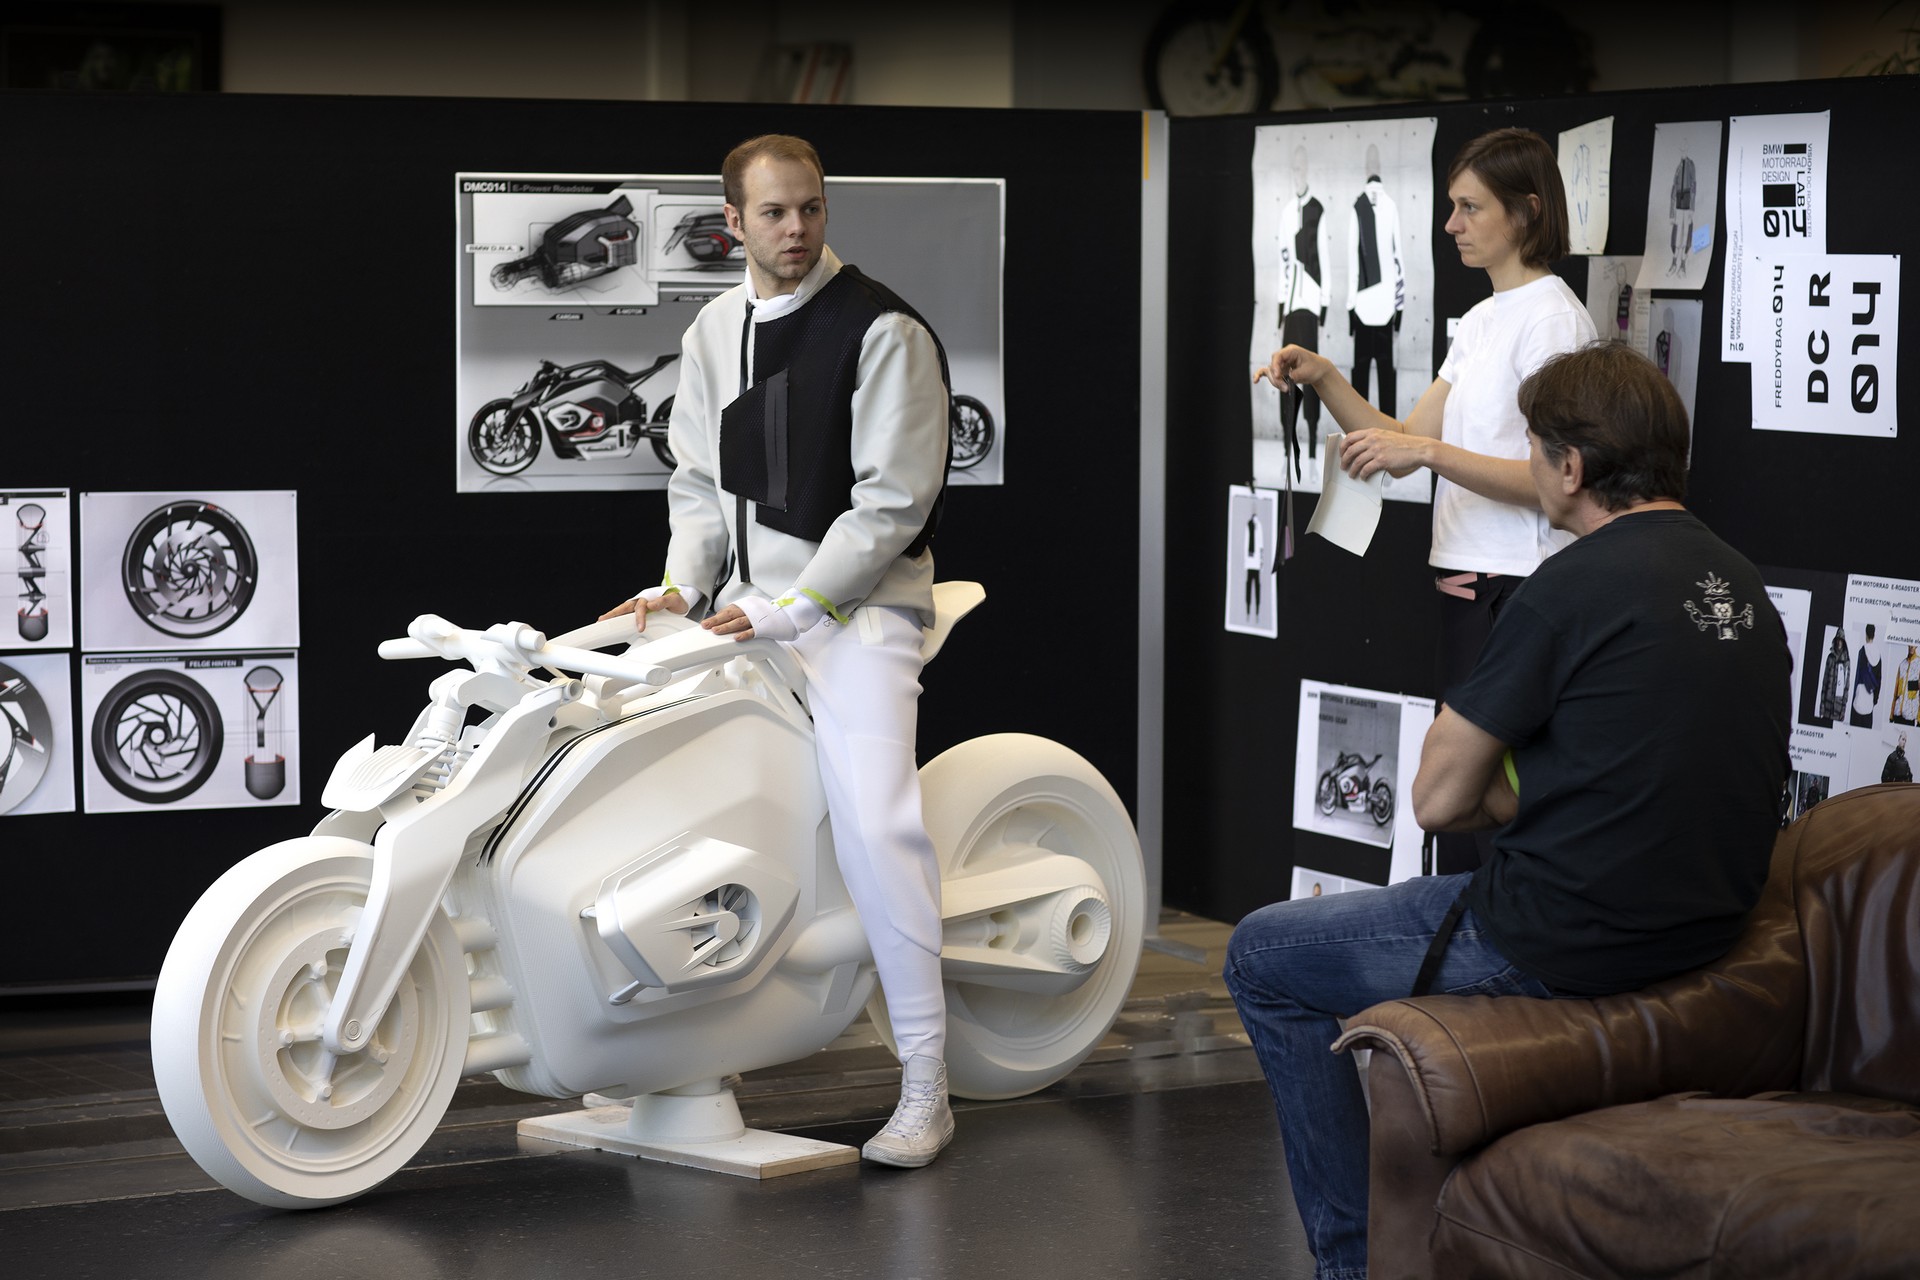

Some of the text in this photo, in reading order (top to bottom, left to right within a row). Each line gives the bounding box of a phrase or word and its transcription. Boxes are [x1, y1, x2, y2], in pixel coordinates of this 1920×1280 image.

[1763, 144, 1782, 155] BMW
[1762, 157, 1807, 169] MOTORRAD
[1762, 171, 1790, 182] DESIGN
[463, 182, 506, 192] DMC014
[1797, 171, 1805, 207] LAB
[1763, 209, 1807, 238] 014
[1773, 265, 1784, 408] FREDDYBAG 014
[1850, 282, 1881, 414] 014
[1863, 581, 1889, 589] MOTORRAD
[1891, 584, 1919, 592] E-ROADSTER
[1887, 634, 1913, 643] detachable
[212, 659, 236, 667] HINTEN
[1796, 729, 1824, 738] E-ROADSTER
